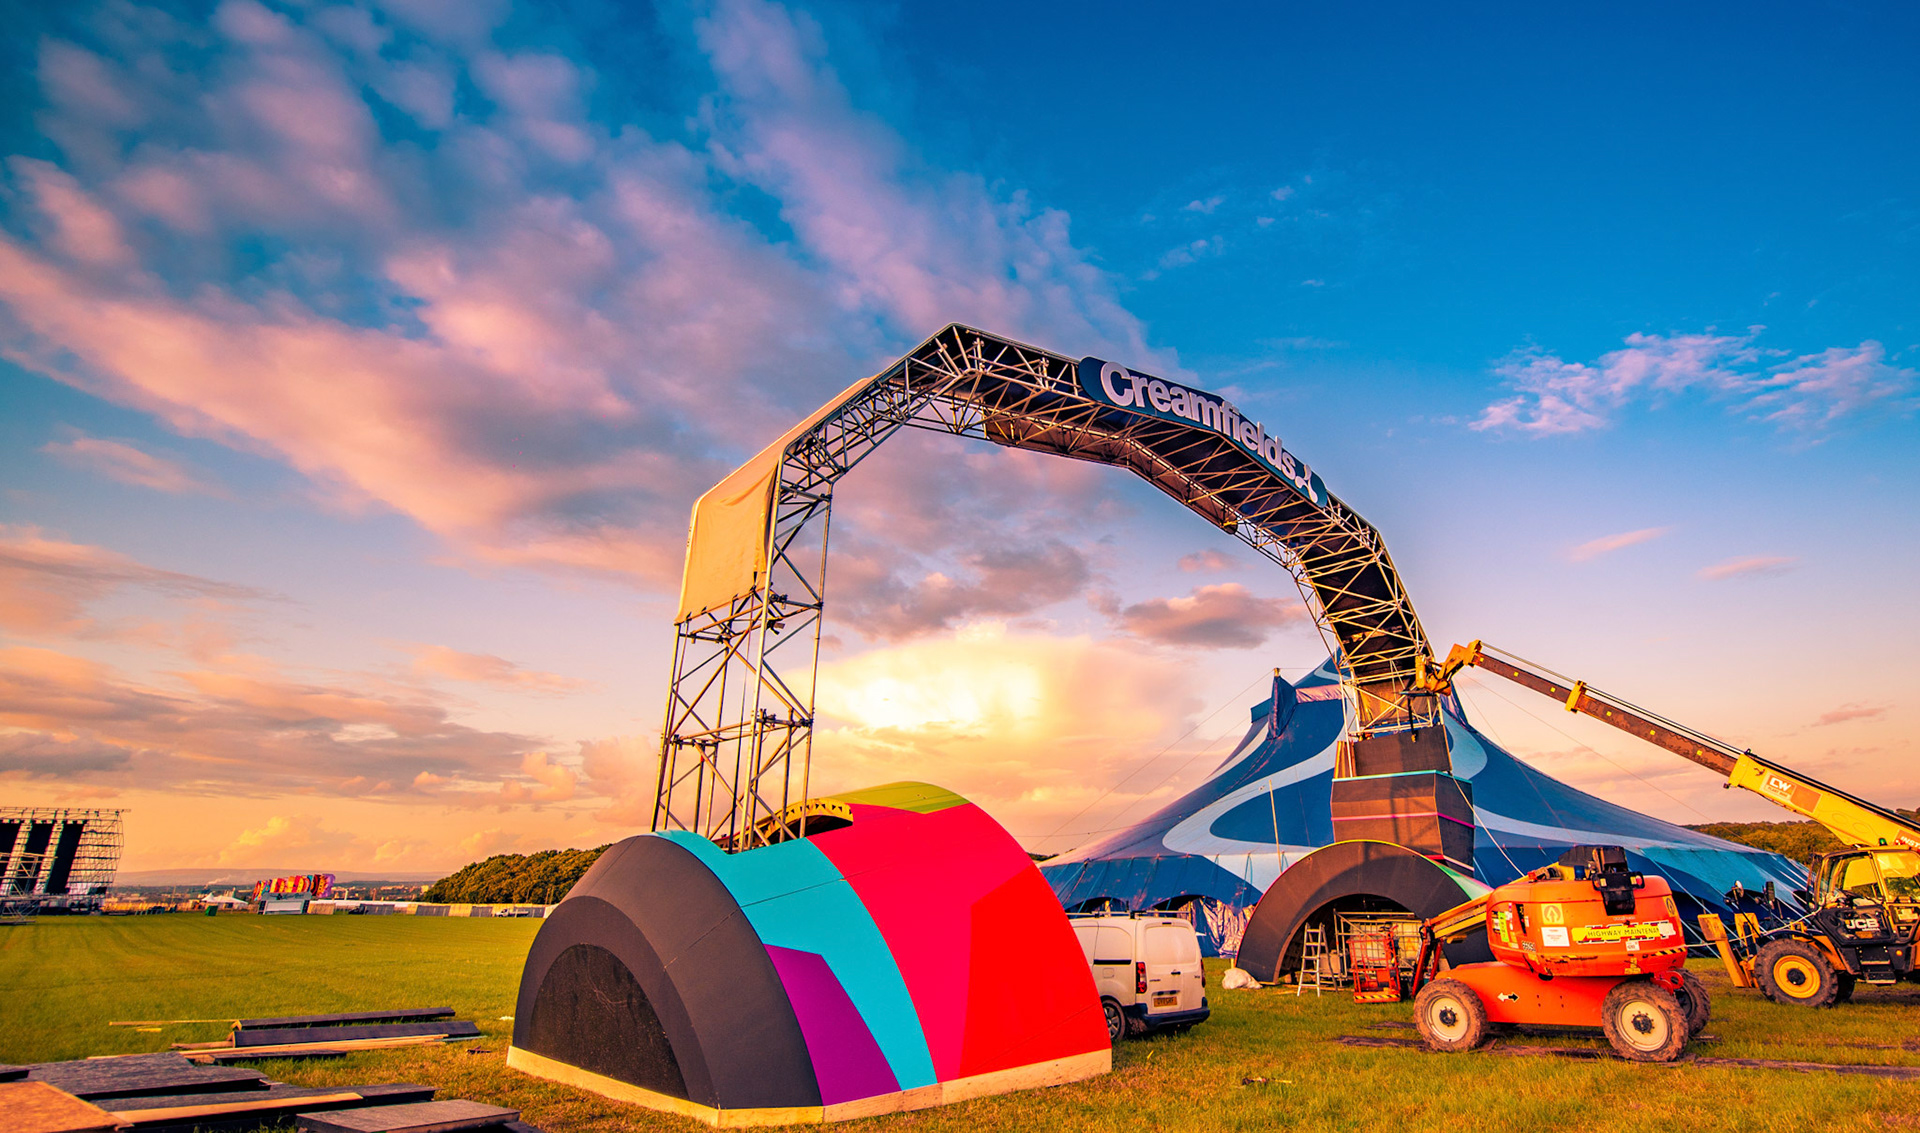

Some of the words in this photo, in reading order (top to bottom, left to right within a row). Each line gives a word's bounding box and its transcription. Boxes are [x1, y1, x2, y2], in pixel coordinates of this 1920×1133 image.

[1100, 361, 1297, 481] Creamfields
[1769, 777, 1792, 791] CW
[1900, 836, 1920, 849] INST
[1845, 918, 1880, 929] JCB
[1587, 929, 1622, 937] HIGHWAY
